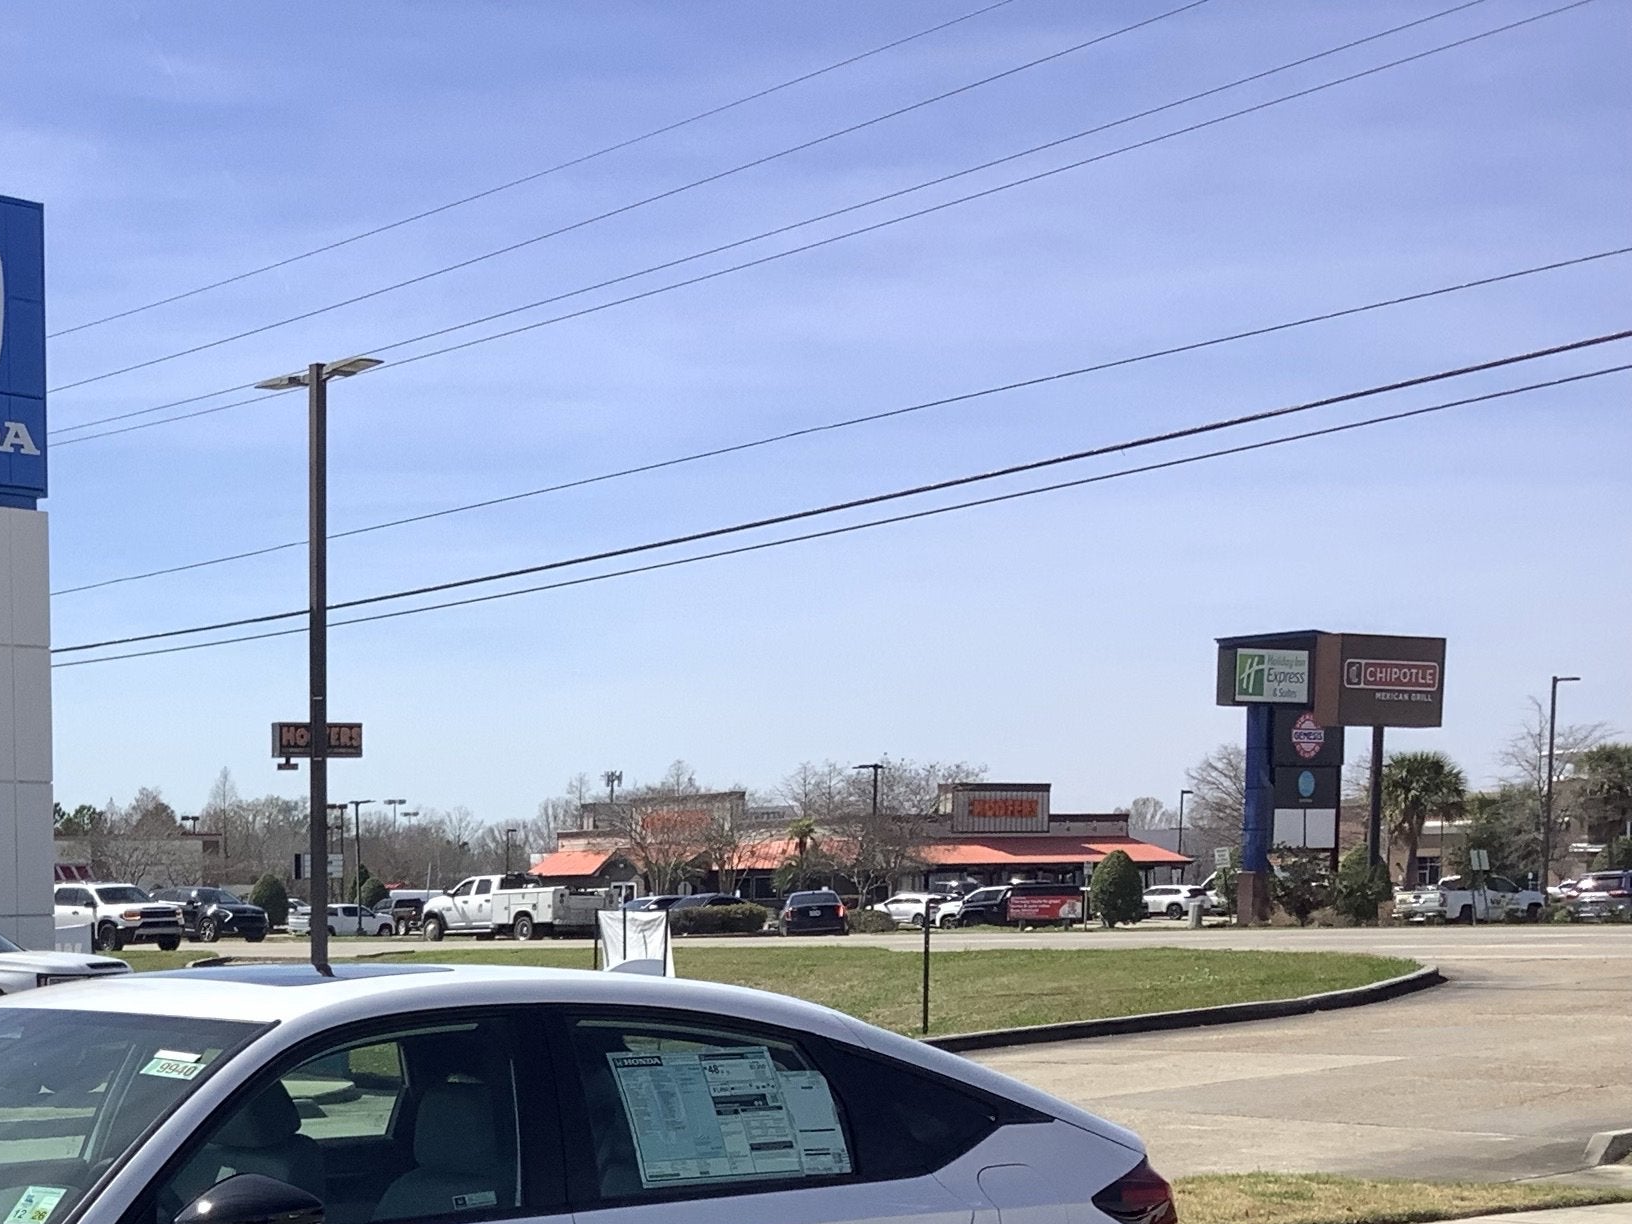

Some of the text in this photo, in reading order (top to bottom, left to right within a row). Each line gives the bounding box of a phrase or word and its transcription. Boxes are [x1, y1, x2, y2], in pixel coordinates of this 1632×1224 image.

[1267, 667, 1305, 686] Express
[1366, 667, 1434, 684] CHIPOTLE
[1375, 691, 1432, 702] MEXICAN GRILL
[281, 726, 361, 747] HOERS
[623, 1057, 661, 1068] HONDA
